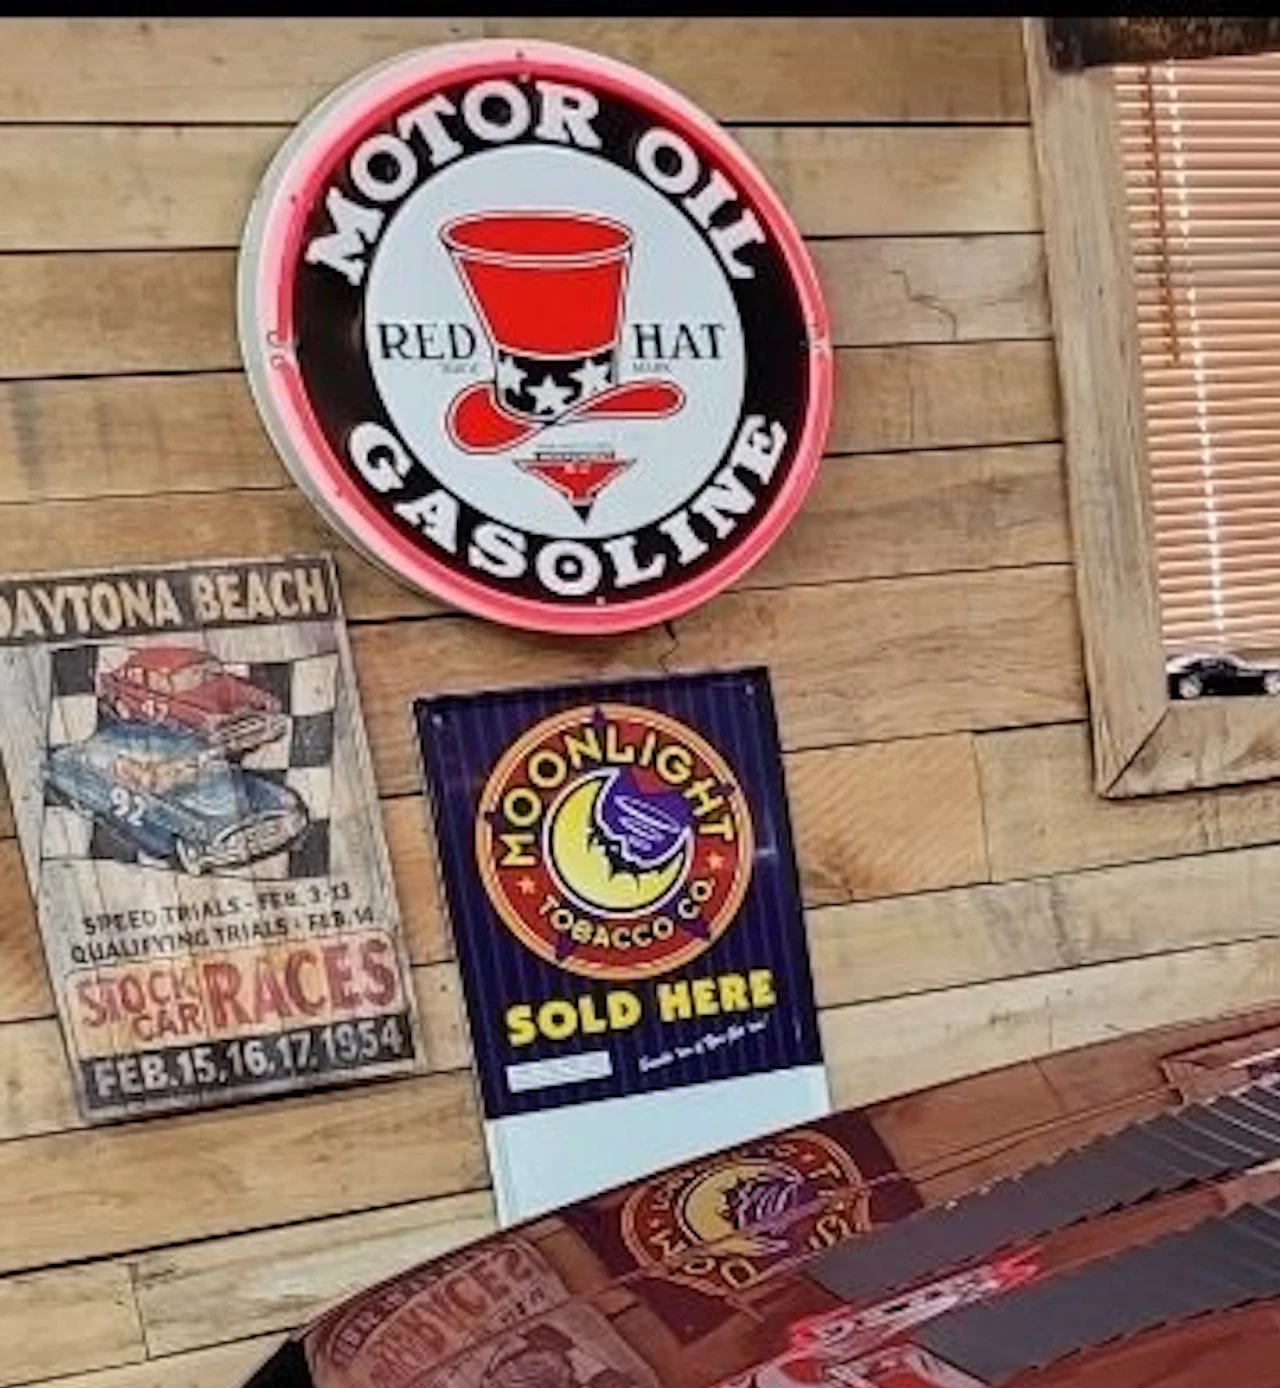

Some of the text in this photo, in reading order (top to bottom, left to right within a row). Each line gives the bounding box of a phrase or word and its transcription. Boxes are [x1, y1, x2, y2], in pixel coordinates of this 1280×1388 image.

[304, 79, 768, 286] MOTOR OIL
[378, 322, 728, 361] RED HAT
[346, 413, 788, 597] GASOLINE
[197, 567, 328, 624] BEACH
[110, 786, 144, 826] 92
[500, 724, 735, 868] MOONLIGHT
[70, 923, 210, 964] QUALIFYING
[215, 917, 289, 944] TRIALS
[83, 908, 157, 936] SPEED
[164, 894, 240, 922] TRIALS
[538, 893, 675, 950] TOBACCO
[134, 937, 398, 1041] CAR RACES
[505, 988, 642, 1047] SOLD
[656, 967, 778, 1023] HERE
